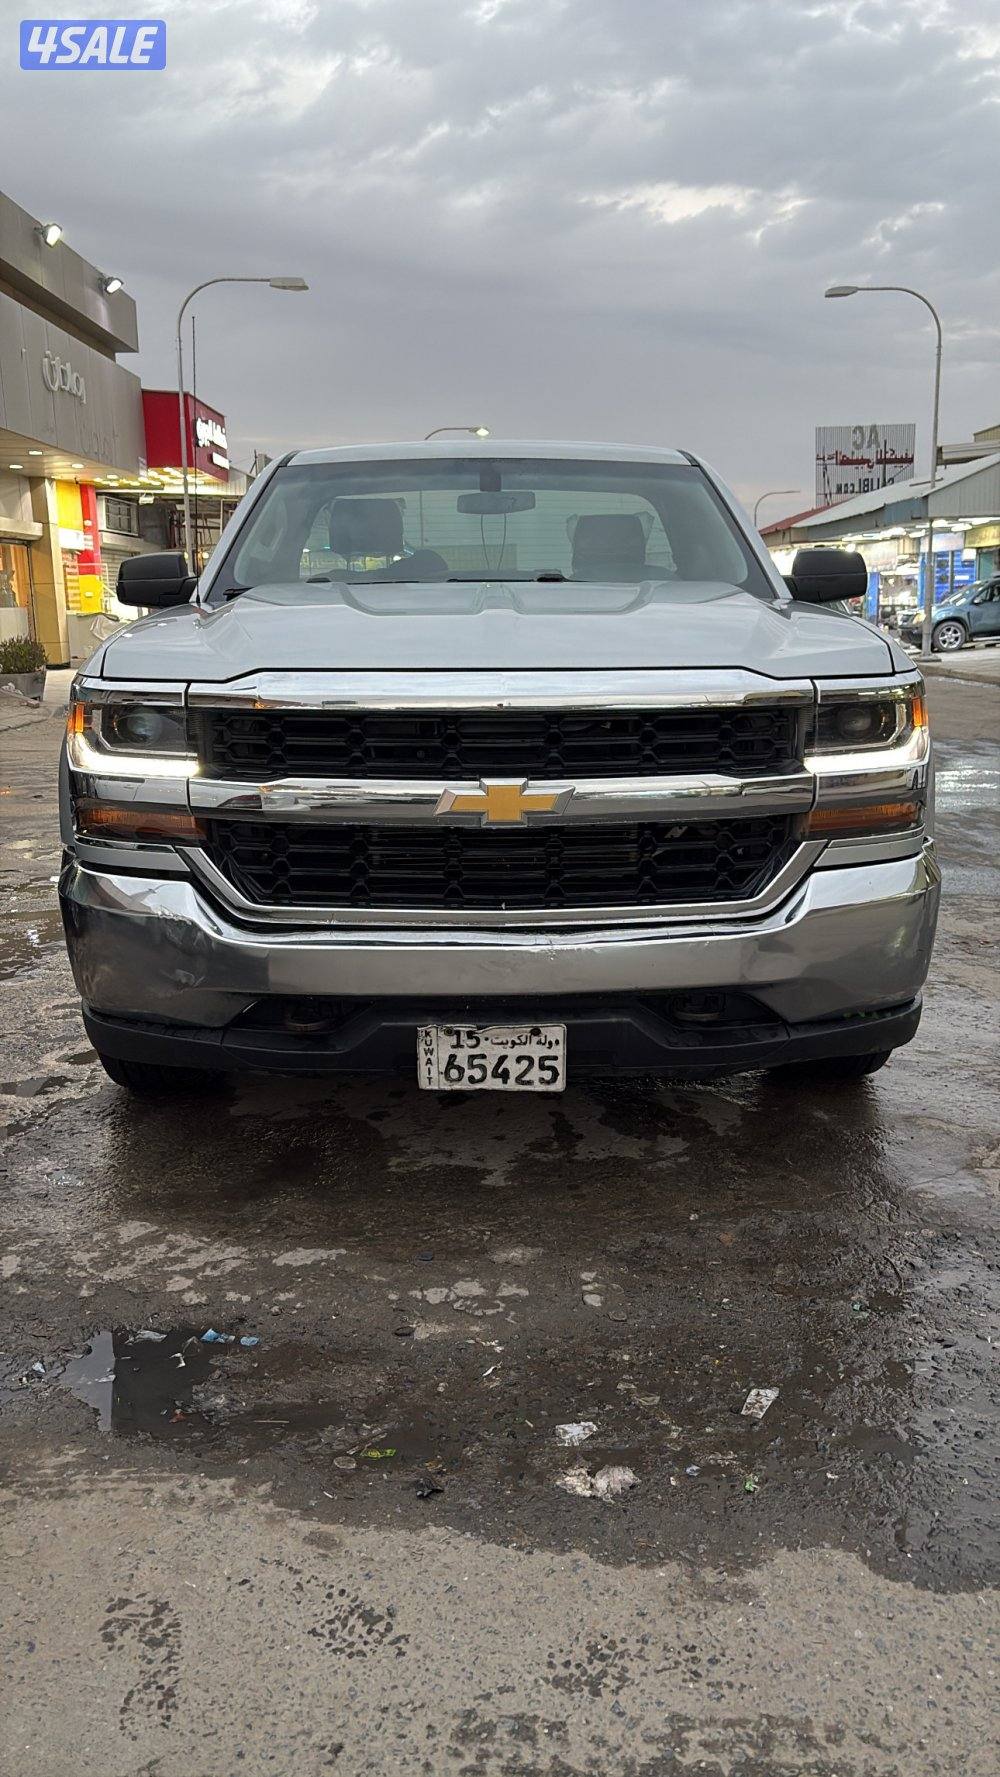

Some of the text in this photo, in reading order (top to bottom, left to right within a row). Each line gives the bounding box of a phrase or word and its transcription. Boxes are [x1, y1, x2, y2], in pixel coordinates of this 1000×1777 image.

[451, 1030, 481, 1049] 15
[423, 1029, 434, 1086] KUWAIT
[444, 1053, 560, 1086] 65425
